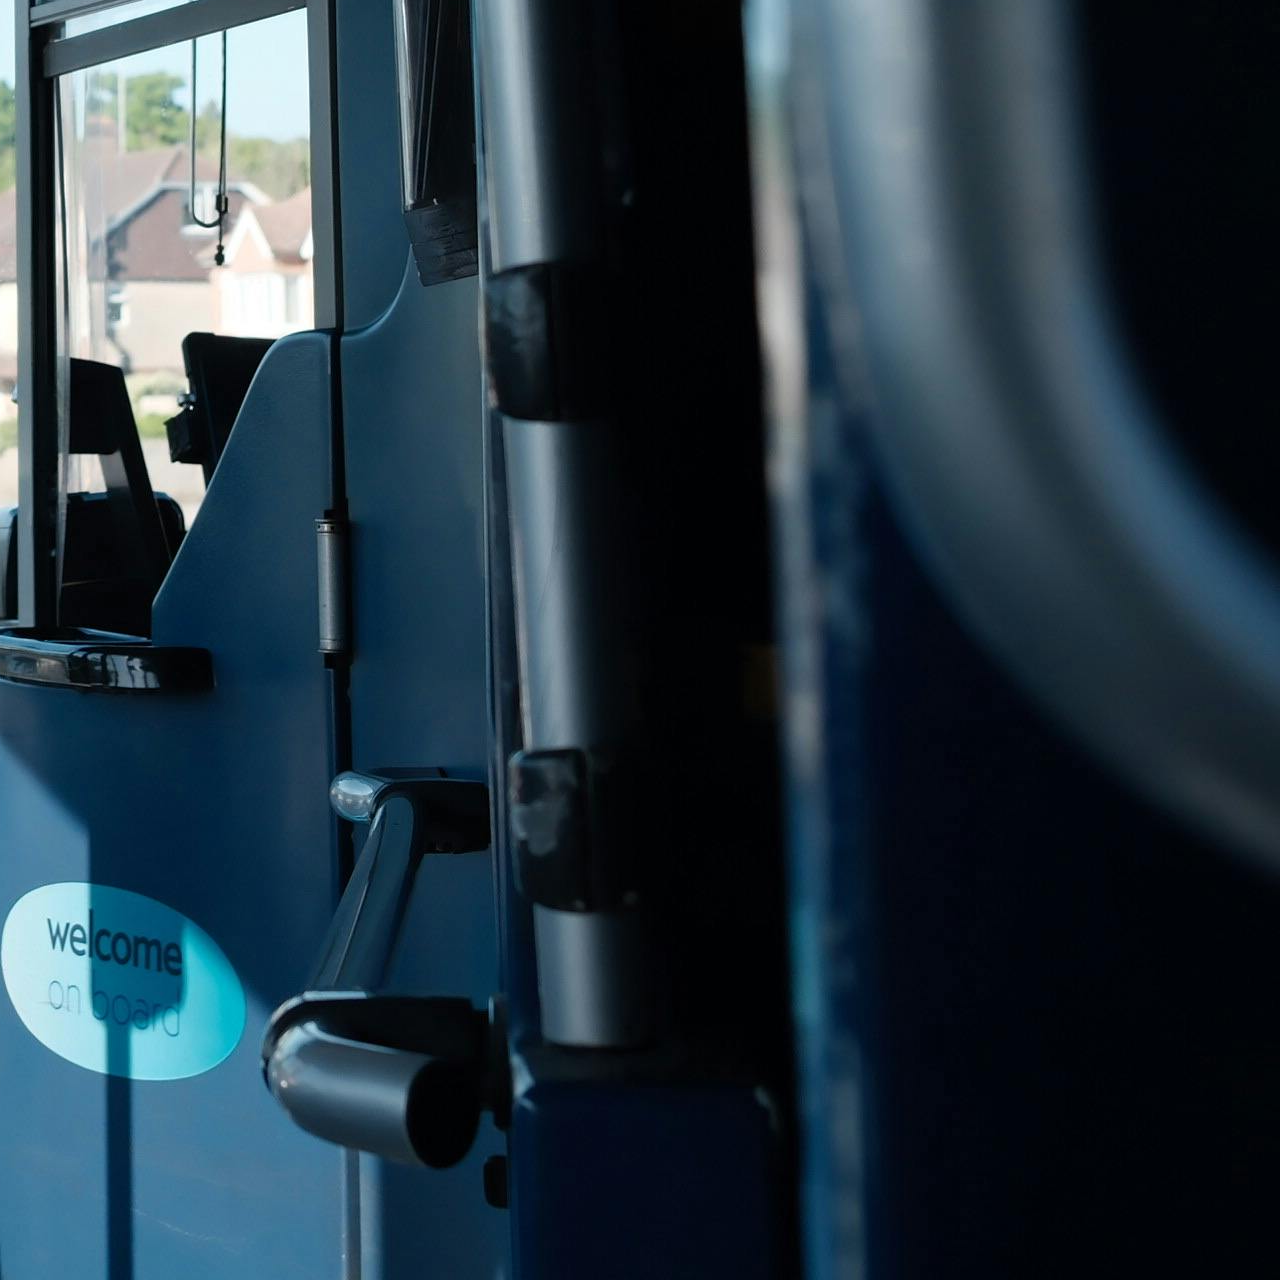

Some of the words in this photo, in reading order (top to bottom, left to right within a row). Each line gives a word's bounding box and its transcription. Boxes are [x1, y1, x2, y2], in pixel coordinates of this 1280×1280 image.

[46, 908, 183, 977] welcome
[46, 978, 82, 1014] on
[91, 986, 182, 1038] board
